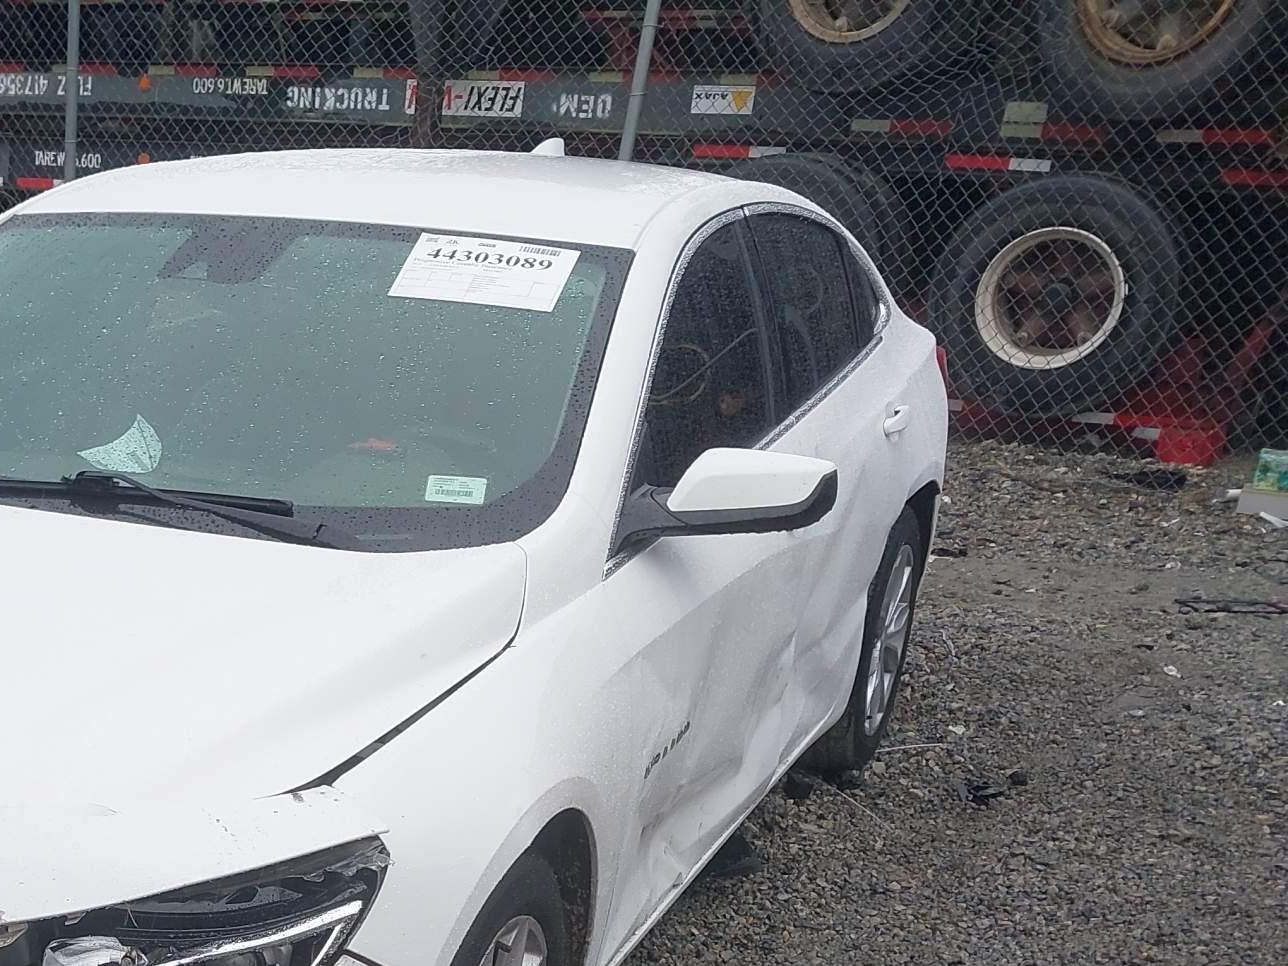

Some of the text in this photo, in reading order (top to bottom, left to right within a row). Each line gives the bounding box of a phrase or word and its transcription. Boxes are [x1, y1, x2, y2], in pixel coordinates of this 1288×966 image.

[286, 86, 390, 110] TRUCKING
[694, 92, 729, 101] AJAX
[426, 247, 554, 271] 44303089
